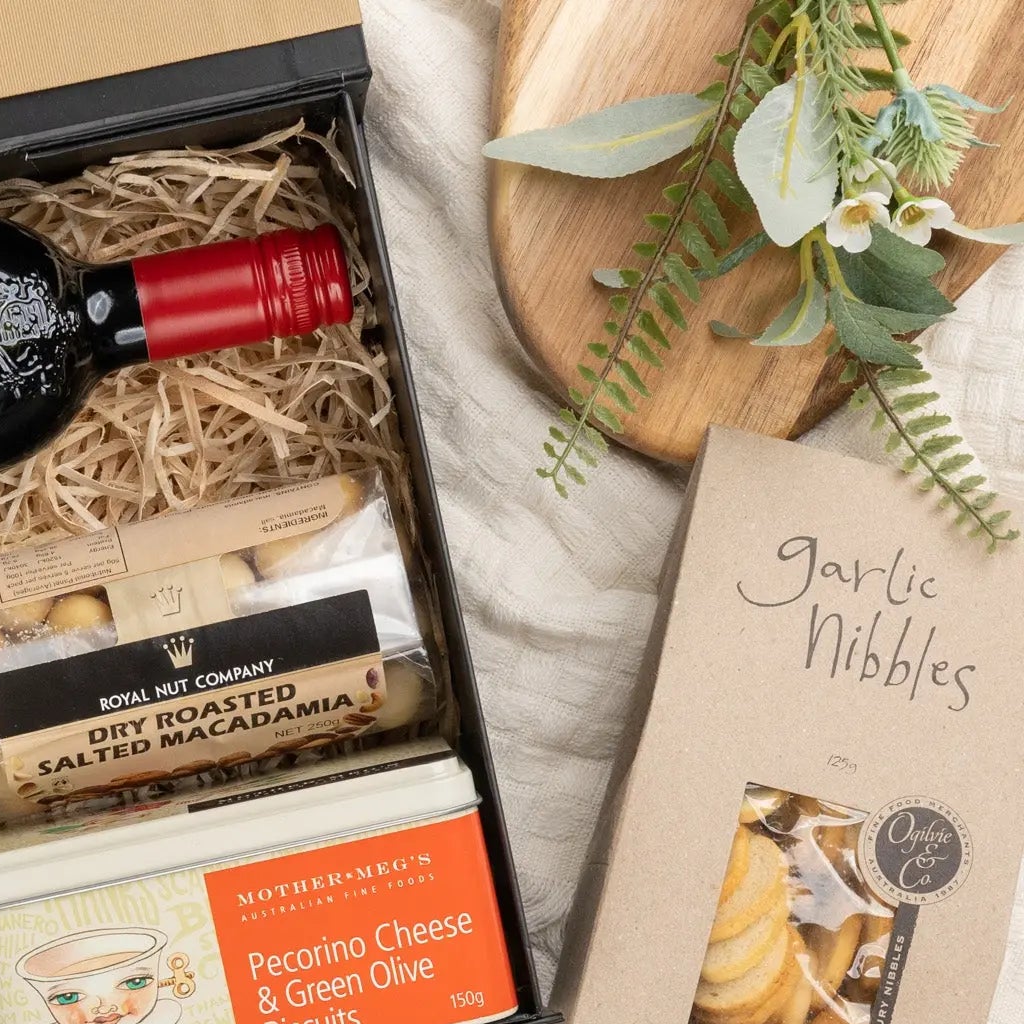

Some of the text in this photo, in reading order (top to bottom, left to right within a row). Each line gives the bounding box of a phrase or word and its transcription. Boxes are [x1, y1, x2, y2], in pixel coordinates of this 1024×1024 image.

[259, 511, 328, 533] INGREDIENTS:
[737, 536, 938, 607] garlic
[99, 659, 274, 711] ROYAL NUT COMPANY
[38, 739, 151, 776] SALTED
[160, 693, 354, 748] MACADAMIA
[88, 683, 296, 745] DRY ROASTED
[275, 719, 340, 738] NET 250g
[827, 754, 857, 774] 125g
[868, 799, 970, 864] FINE FOOD MERCHANTS
[888, 811, 952, 853] Ogilvie
[916, 844, 949, 868] &
[236, 872, 344, 907] MOTHER
[241, 873, 435, 922] AUSTRALIAN FINE FOODS
[869, 859, 927, 902] AUSTRALIA
[248, 912, 473, 980] Pecorino Cheese
[884, 934, 905, 997] NIBBLES
[258, 956, 434, 1015] & Green Olive
[450, 990, 484, 1008] 150g
